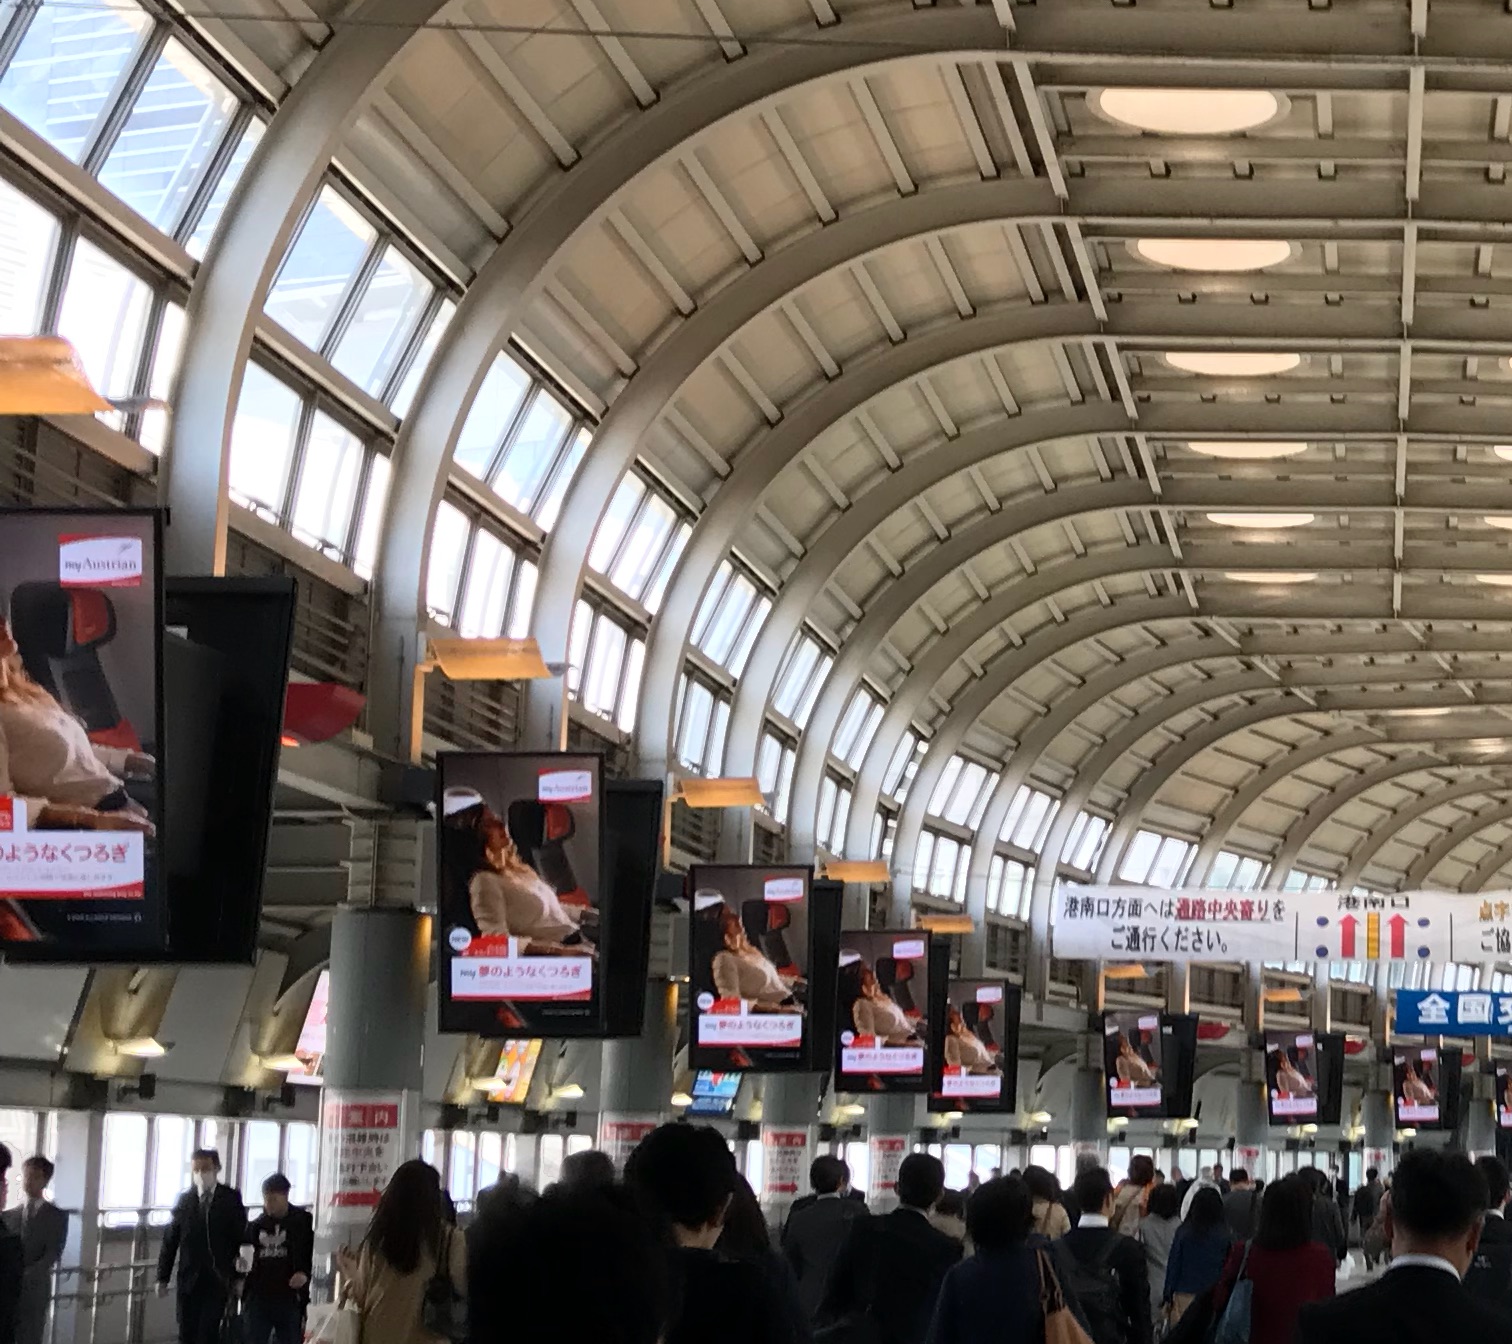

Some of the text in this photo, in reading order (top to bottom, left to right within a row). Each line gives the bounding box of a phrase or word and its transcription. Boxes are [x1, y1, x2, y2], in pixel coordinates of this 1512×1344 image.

[0, 842, 129, 863] ようなくつろぎ
[1111, 925, 1228, 953] ご通行ください。
